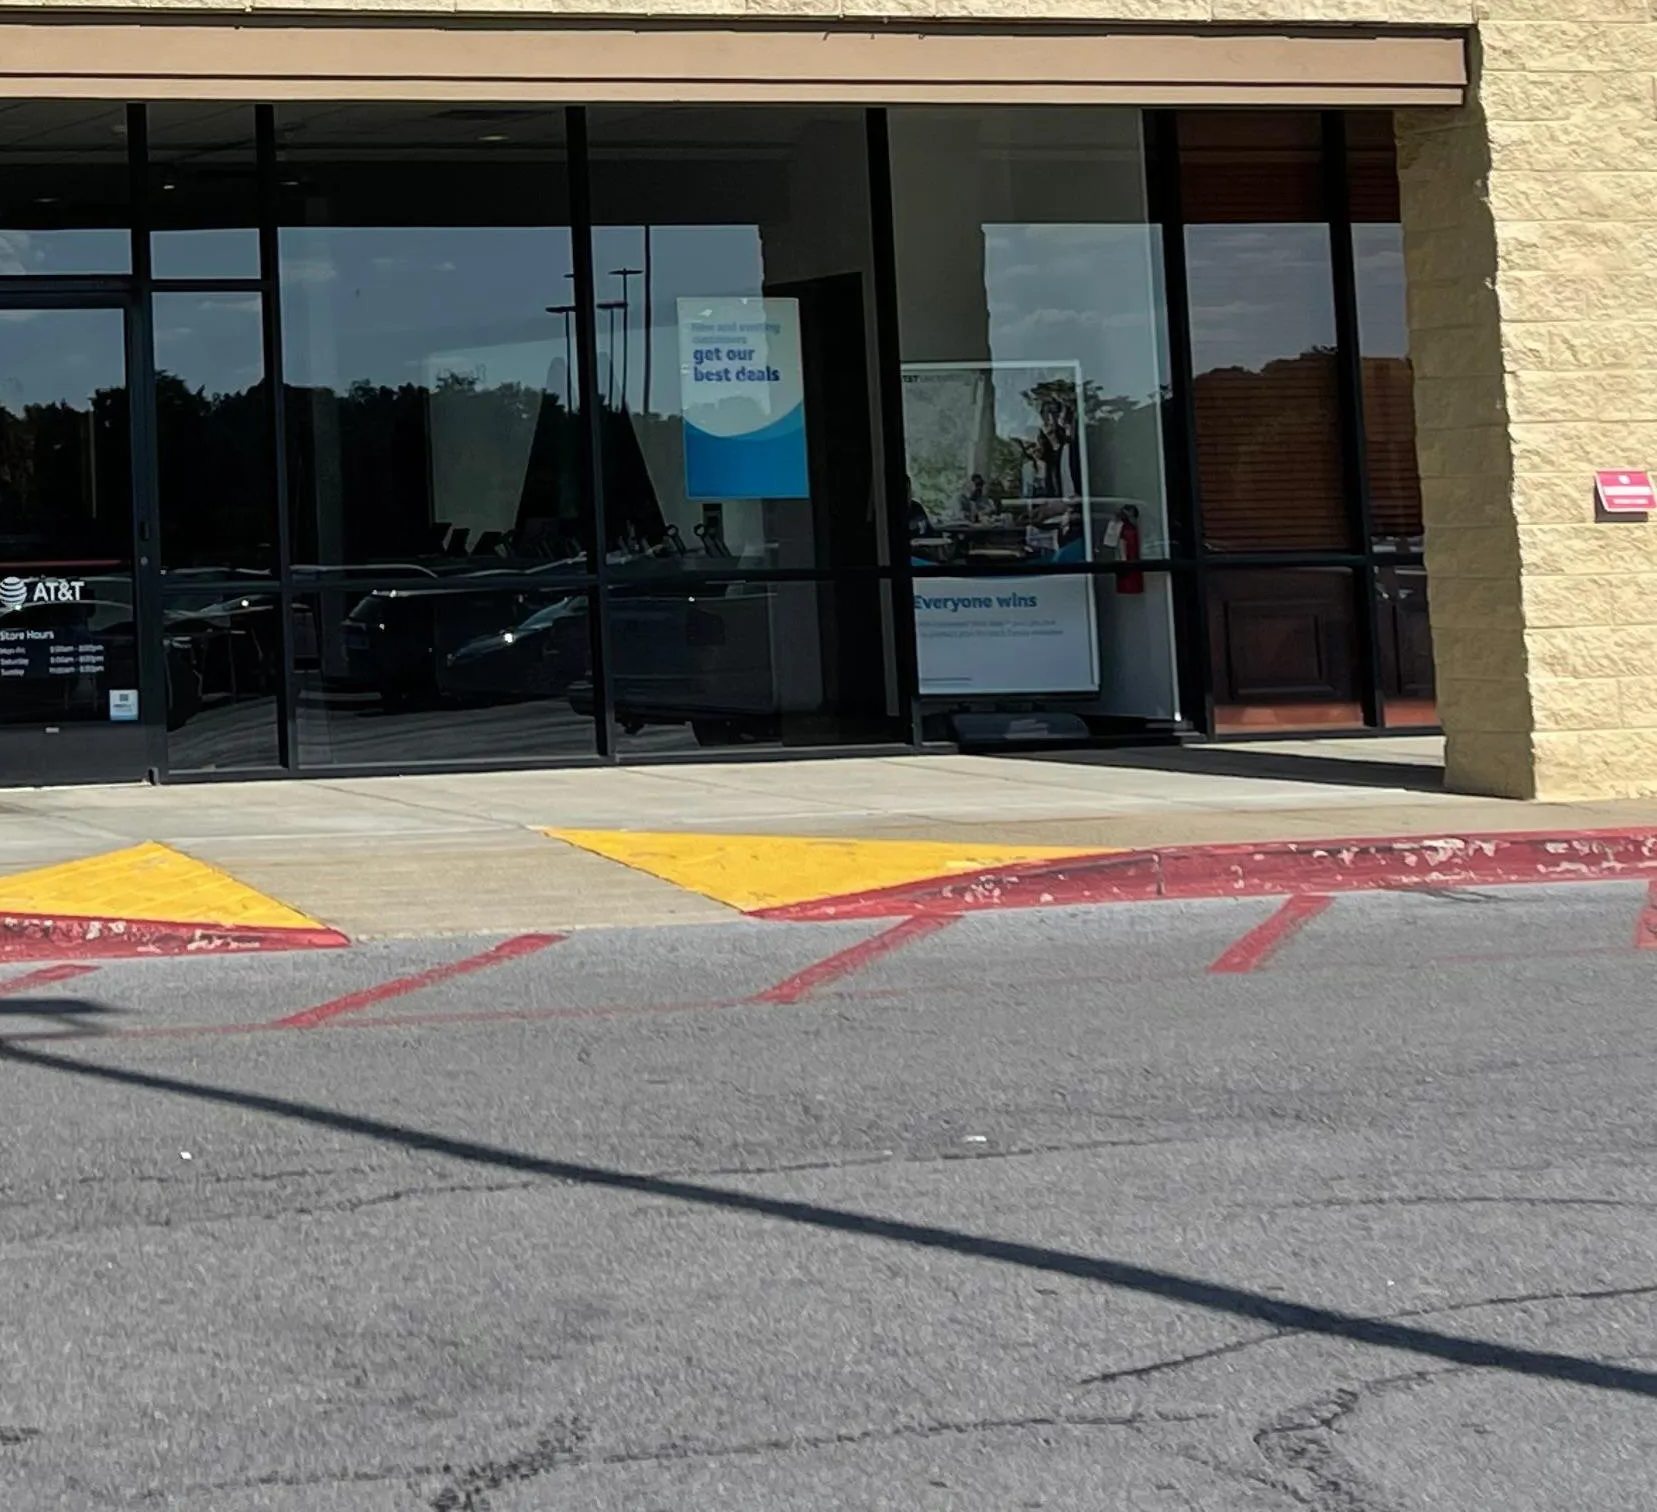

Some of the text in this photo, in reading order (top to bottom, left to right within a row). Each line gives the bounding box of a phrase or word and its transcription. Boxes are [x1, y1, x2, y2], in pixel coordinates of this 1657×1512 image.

[693, 347, 756, 365] get our
[693, 365, 781, 382] best deals
[33, 581, 85, 601] AT&T
[913, 592, 1038, 613] Everyone wins
[0, 630, 55, 641] Store Hours
